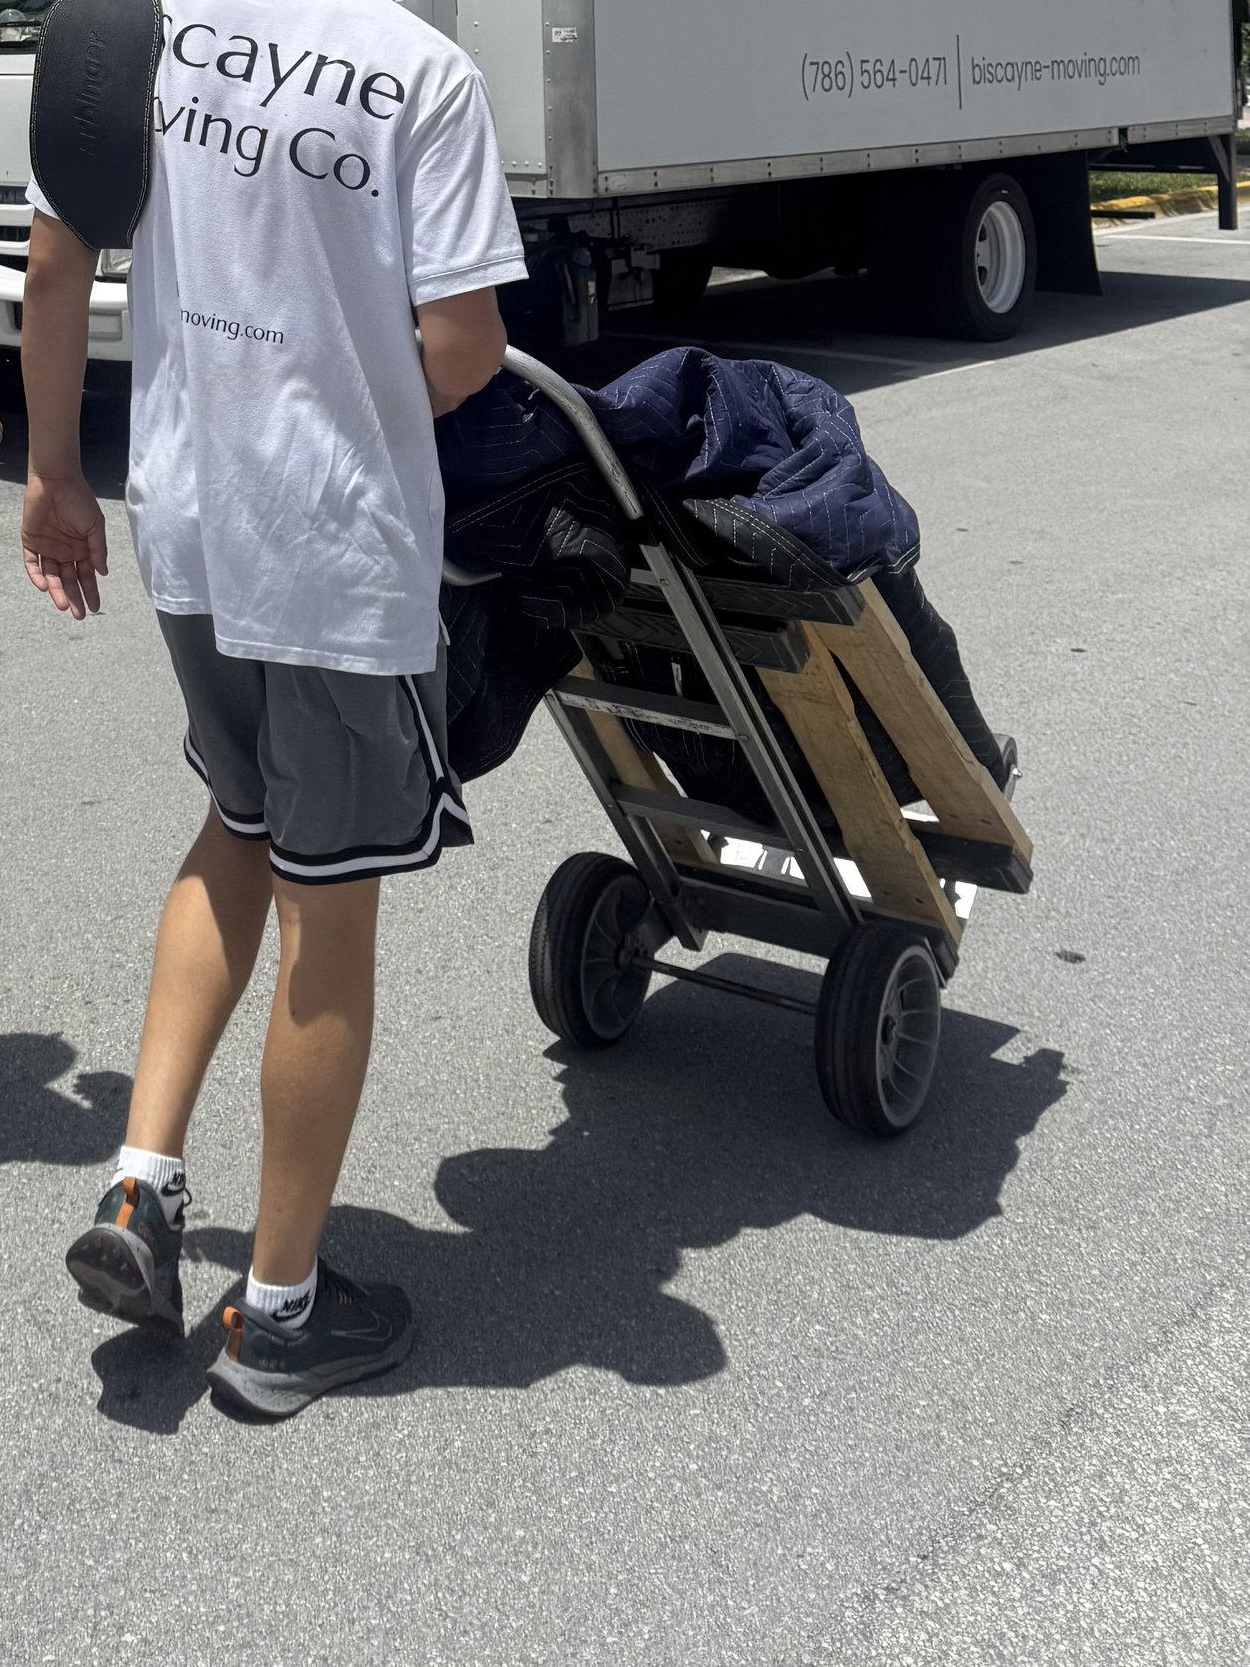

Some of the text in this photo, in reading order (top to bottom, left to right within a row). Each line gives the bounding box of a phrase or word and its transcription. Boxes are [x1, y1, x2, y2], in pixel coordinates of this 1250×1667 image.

[162, 14, 405, 120] cayne
[801, 51, 947, 101] (786) 564-0471
[971, 52, 1141, 92] biscayne-moving.com
[154, 97, 380, 198] ving Co.
